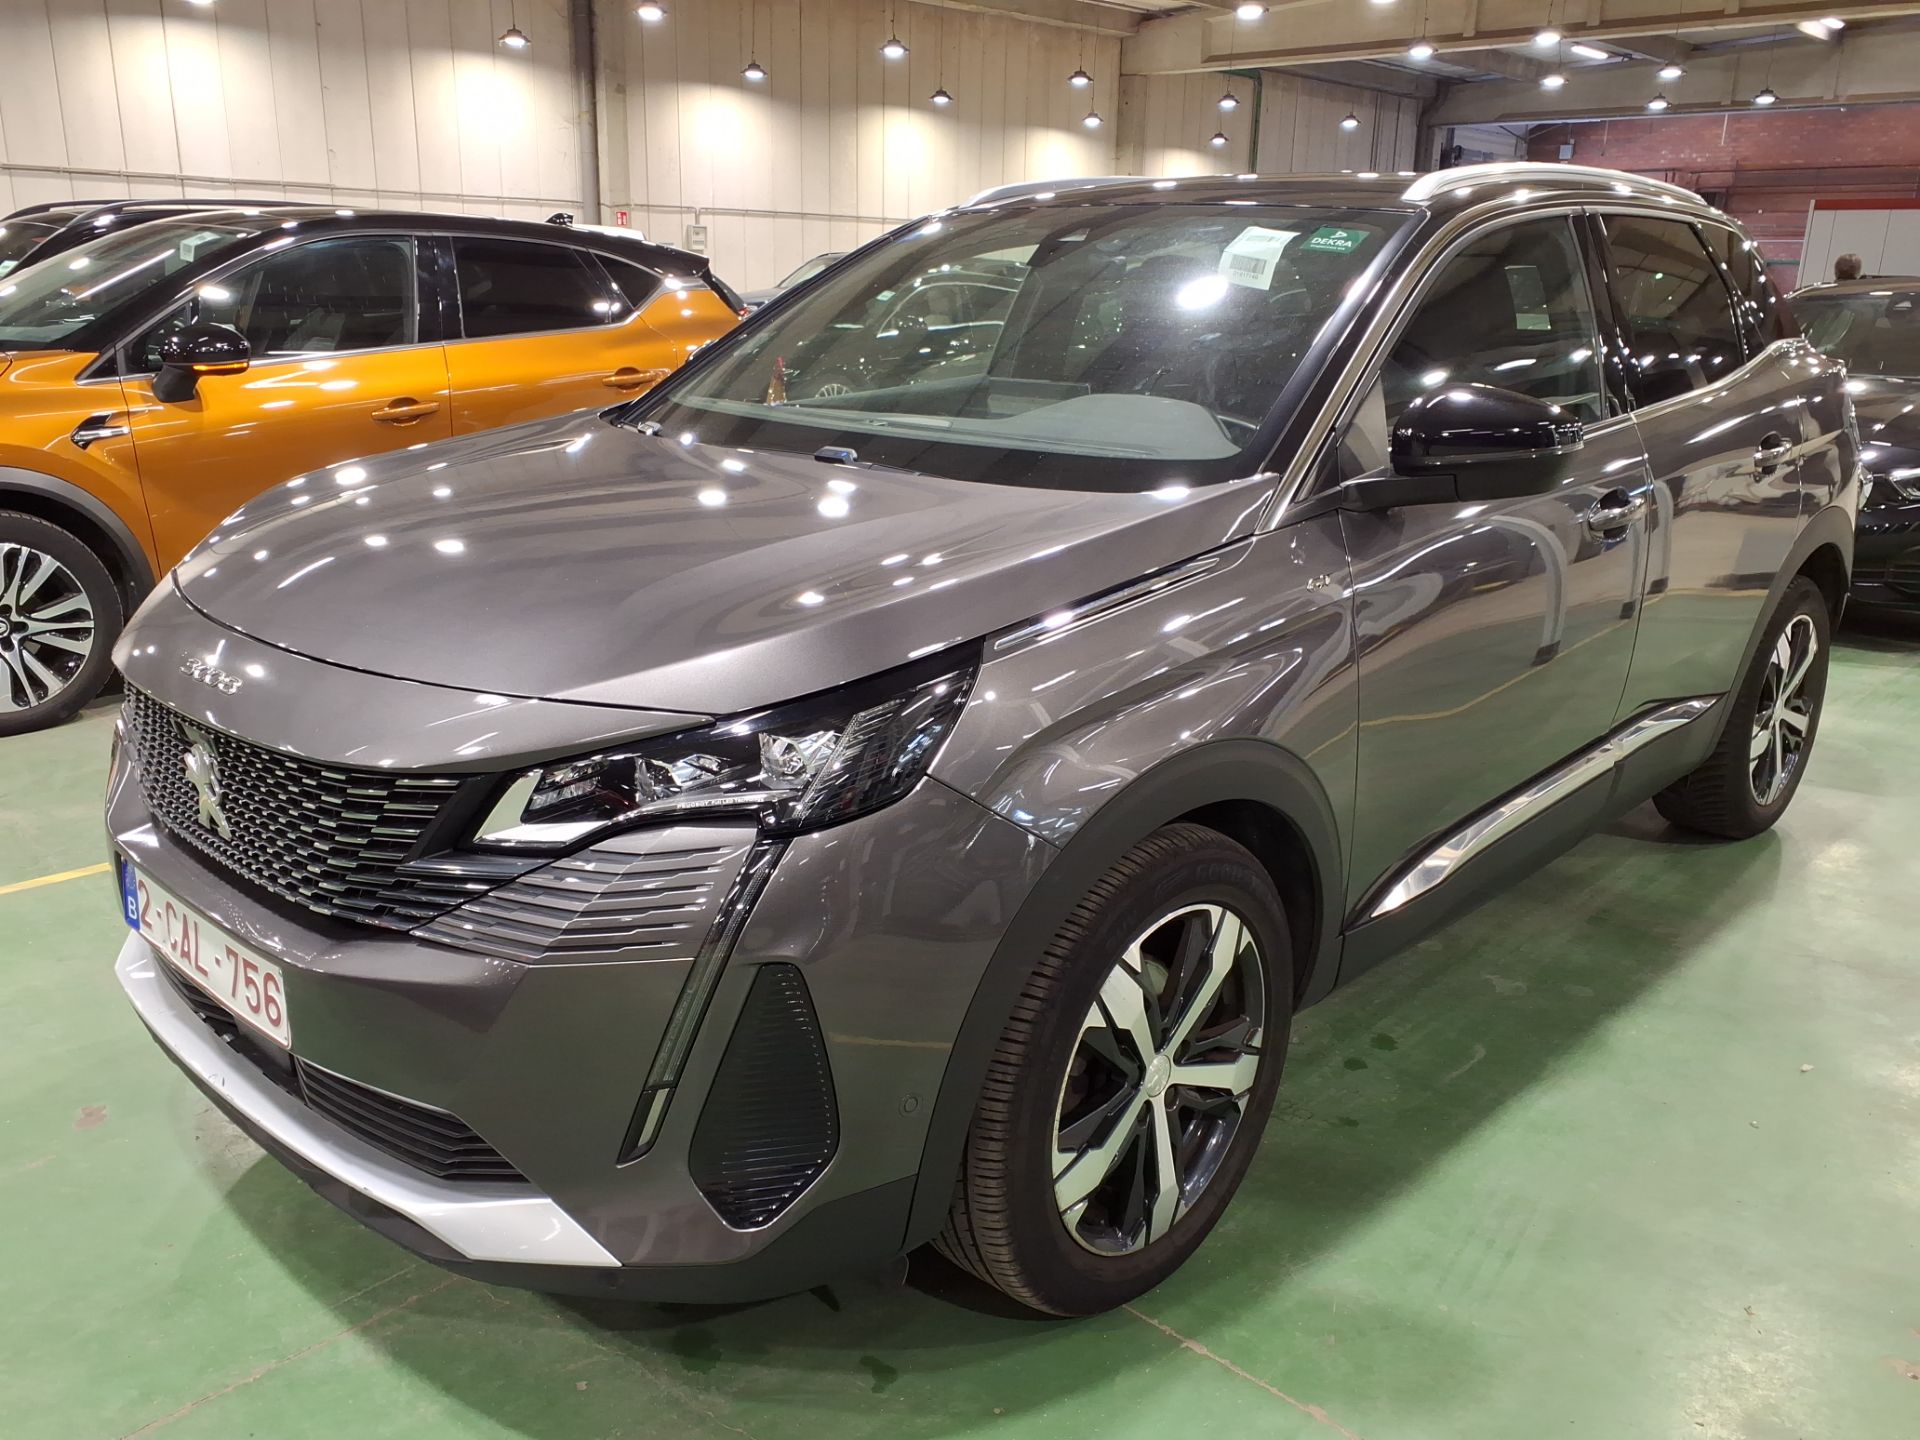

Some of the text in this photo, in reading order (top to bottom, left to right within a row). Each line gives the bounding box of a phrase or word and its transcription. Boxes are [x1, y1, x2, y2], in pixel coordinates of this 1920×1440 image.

[1311, 237, 1353, 248] DEKRA
[180, 657, 243, 695] 3008
[126, 895, 138, 920] B
[138, 879, 282, 1027] 2-CAL-756
